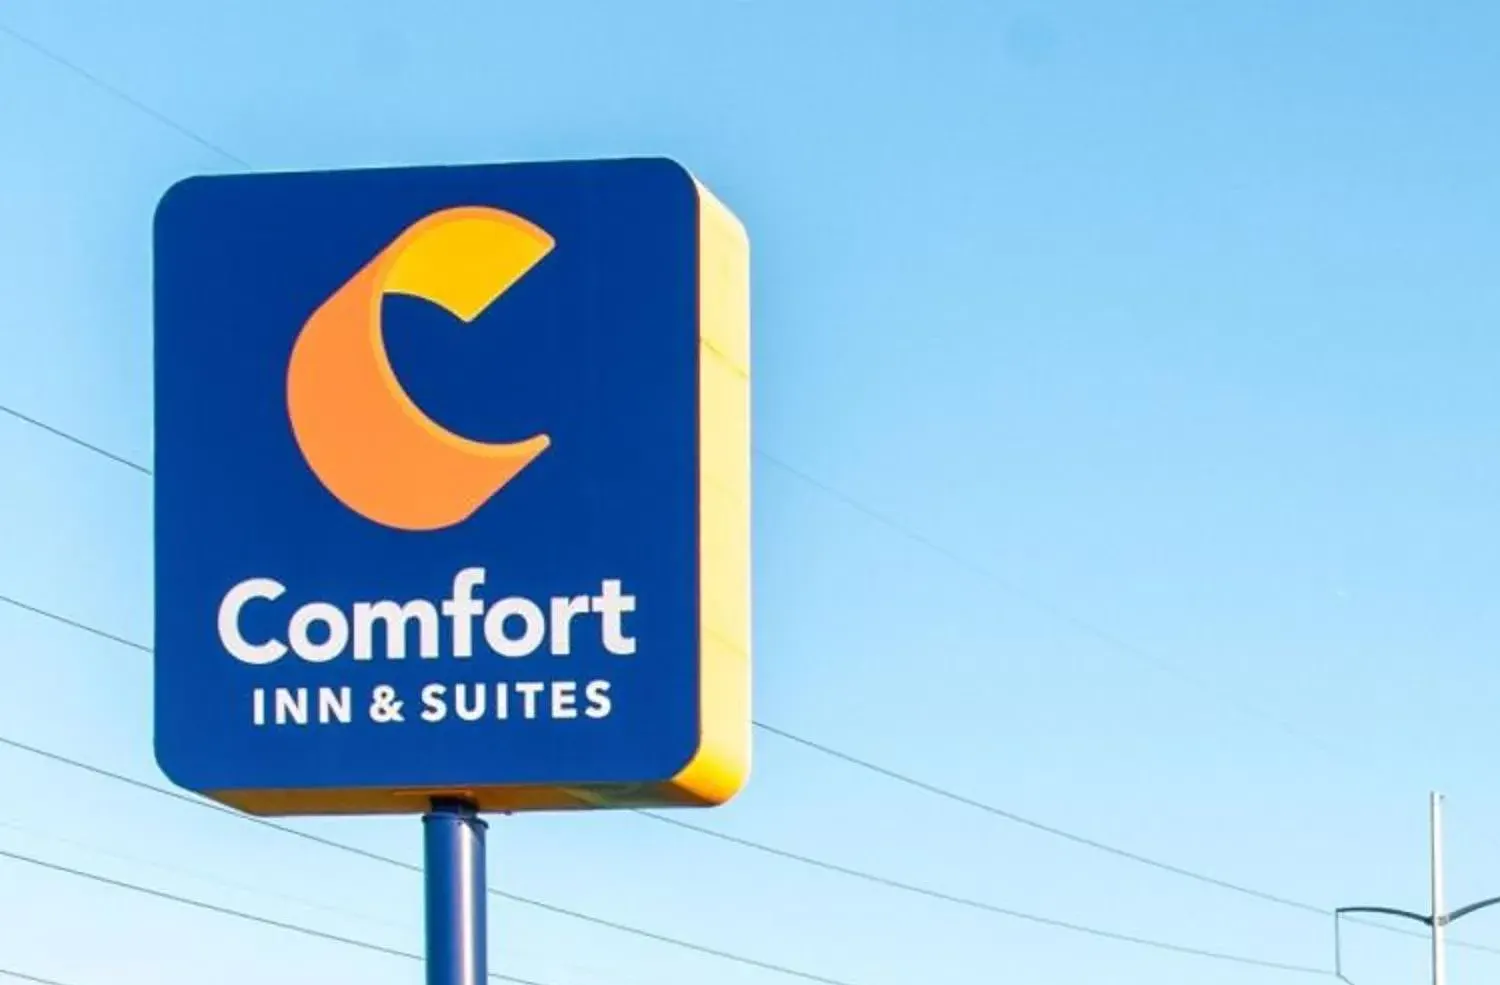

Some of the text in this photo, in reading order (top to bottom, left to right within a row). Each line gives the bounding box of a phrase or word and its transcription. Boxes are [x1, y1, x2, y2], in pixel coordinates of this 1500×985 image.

[217, 567, 636, 665] Comfort
[253, 680, 612, 725] INN & SUITES
